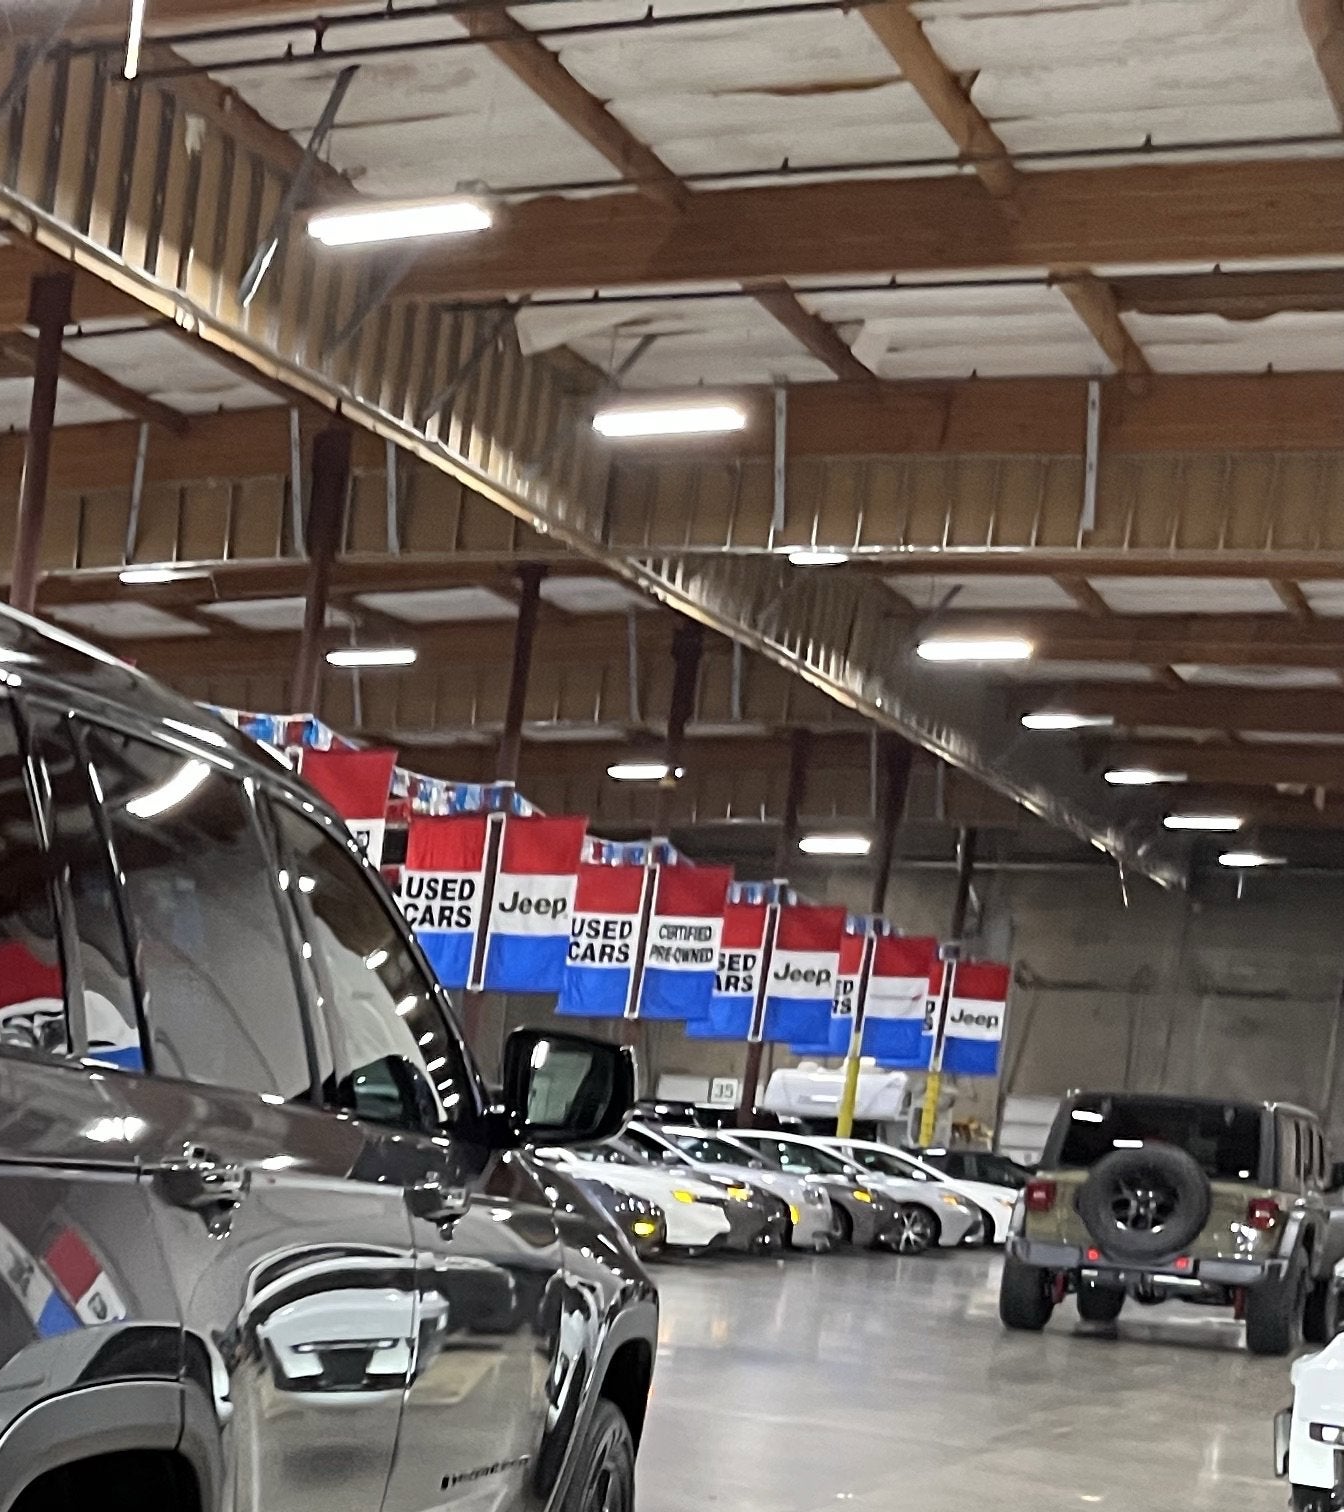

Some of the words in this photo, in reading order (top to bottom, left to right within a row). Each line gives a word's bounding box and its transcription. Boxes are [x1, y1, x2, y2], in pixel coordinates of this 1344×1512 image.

[406, 877, 475, 901] USED
[404, 903, 472, 928] CARS
[499, 891, 567, 919] Jeep
[572, 917, 632, 940] USED
[568, 941, 630, 963] CARS
[717, 953, 757, 971] SED
[773, 962, 831, 987] Jeep
[950, 1009, 999, 1029] Jeep
